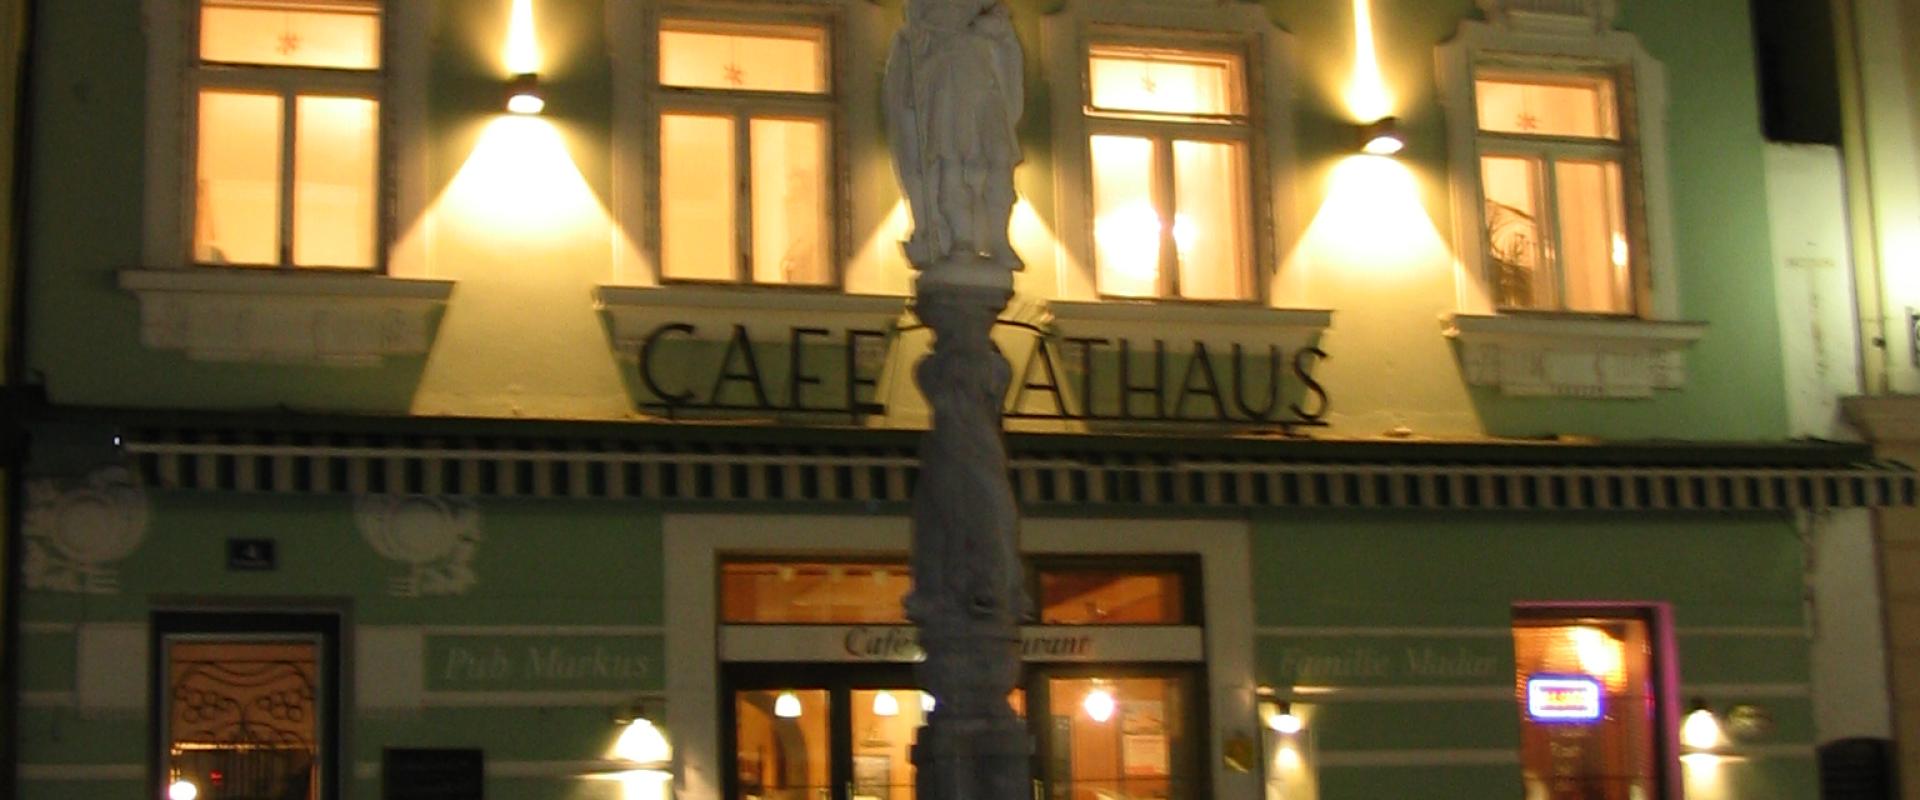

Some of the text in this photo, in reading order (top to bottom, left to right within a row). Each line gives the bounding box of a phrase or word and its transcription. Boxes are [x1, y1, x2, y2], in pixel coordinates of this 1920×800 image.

[639, 322, 1328, 421] CAFE ATHAUS
[445, 645, 648, 678] Pub Markus
